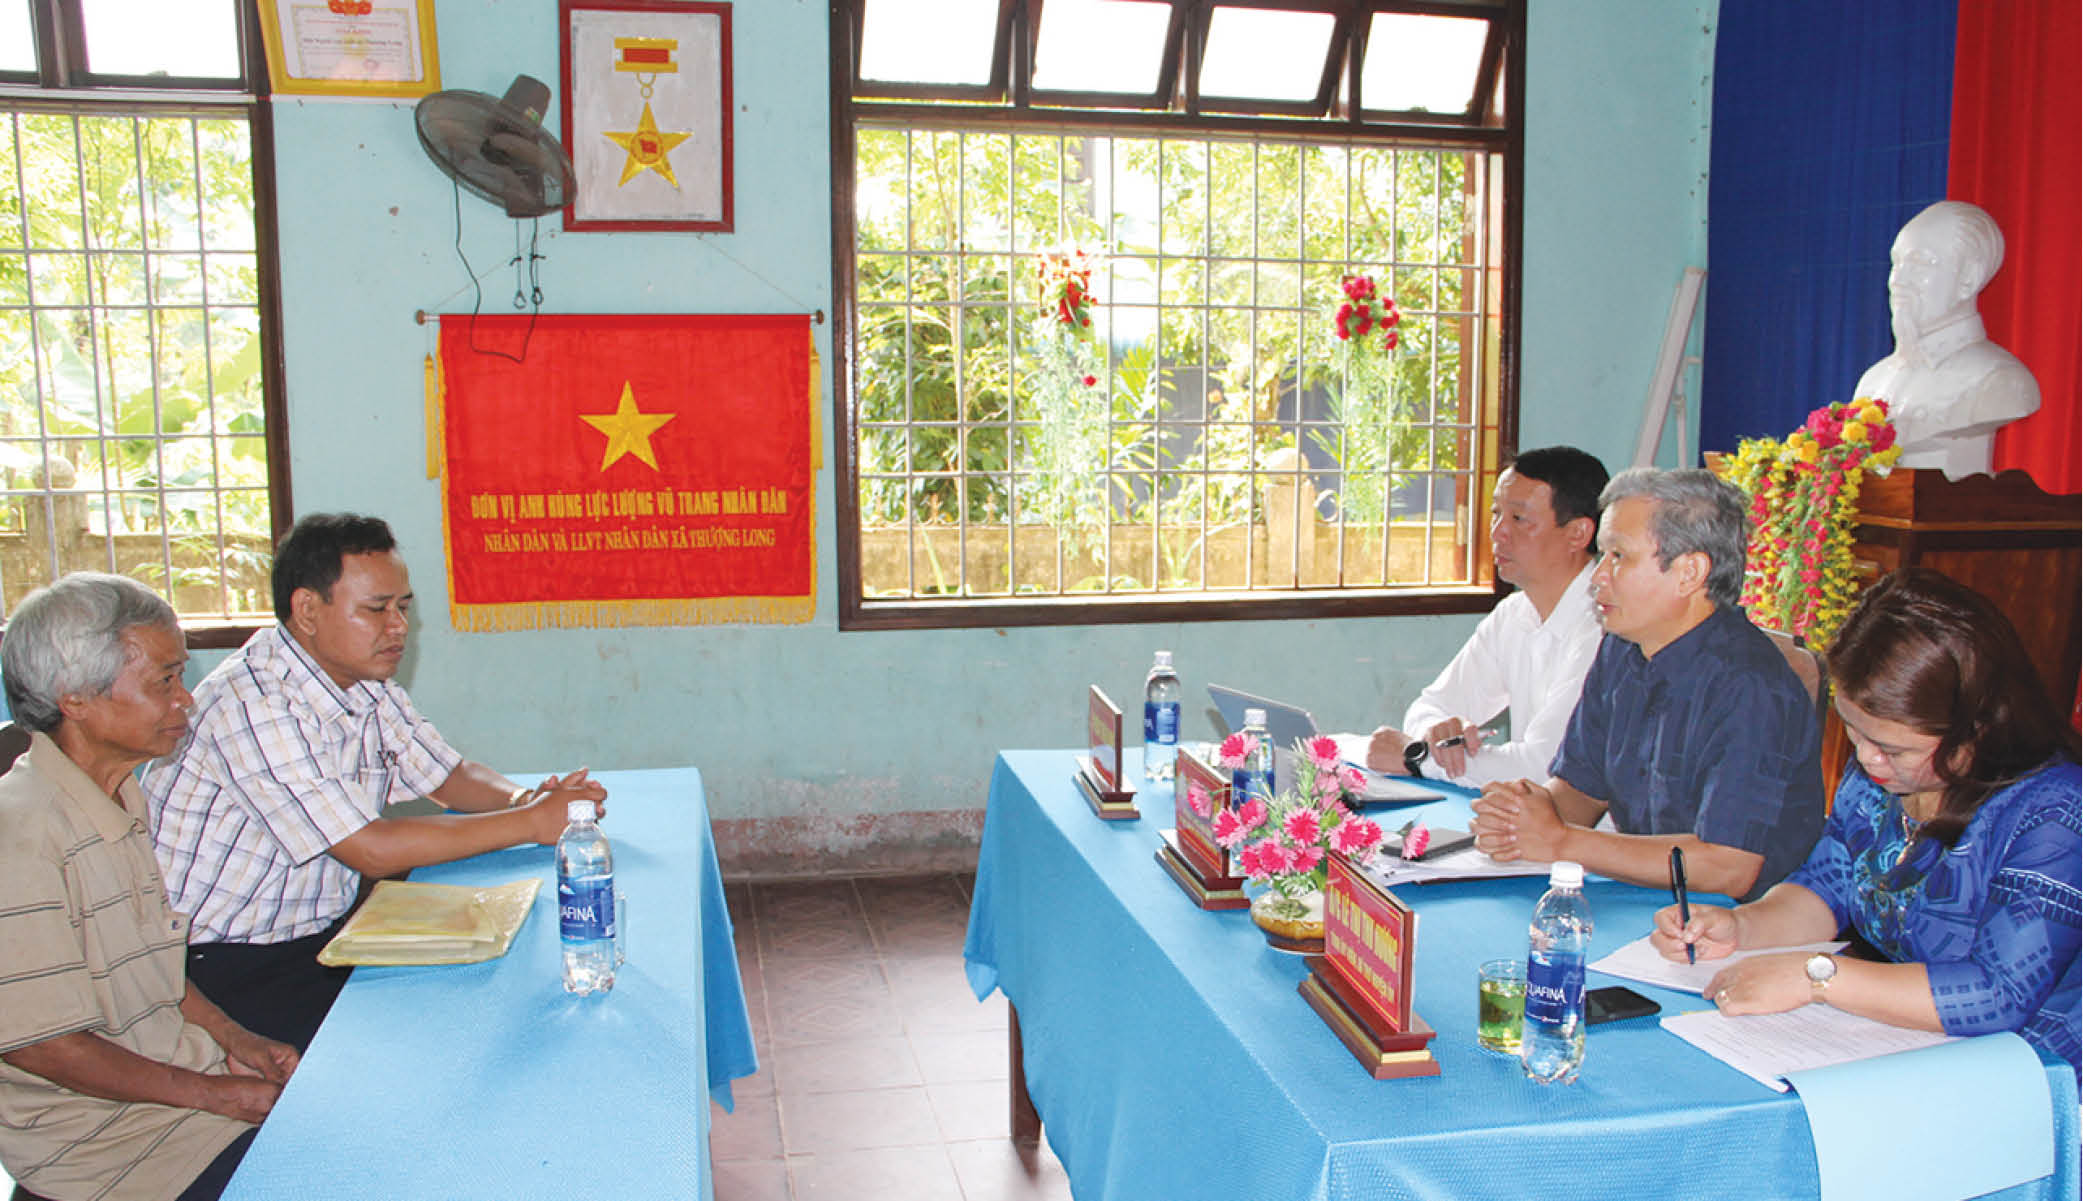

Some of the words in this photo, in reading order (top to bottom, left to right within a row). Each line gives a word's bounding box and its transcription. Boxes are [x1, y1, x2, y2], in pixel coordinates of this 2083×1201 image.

[500, 494, 516, 524] VỊ
[519, 494, 546, 519] ANH
[547, 489, 583, 518] HÙNG
[585, 489, 610, 523] LỰC
[611, 487, 654, 521] LƯỢNG
[656, 486, 675, 516] VŨ
[677, 490, 719, 515] TRANG
[721, 485, 757, 514] NHÂN
[760, 485, 787, 514] DÂN
[484, 528, 521, 553] NHÂN
[522, 528, 549, 553] DÂN
[551, 528, 569, 552] VÀ
[571, 531, 602, 551] LLVT
[605, 525, 640, 550] NHÂN
[641, 524, 669, 549] DÂN
[671, 525, 689, 549] XÃ
[689, 525, 740, 552] THƯỢNG
[742, 528, 776, 548] LONG
